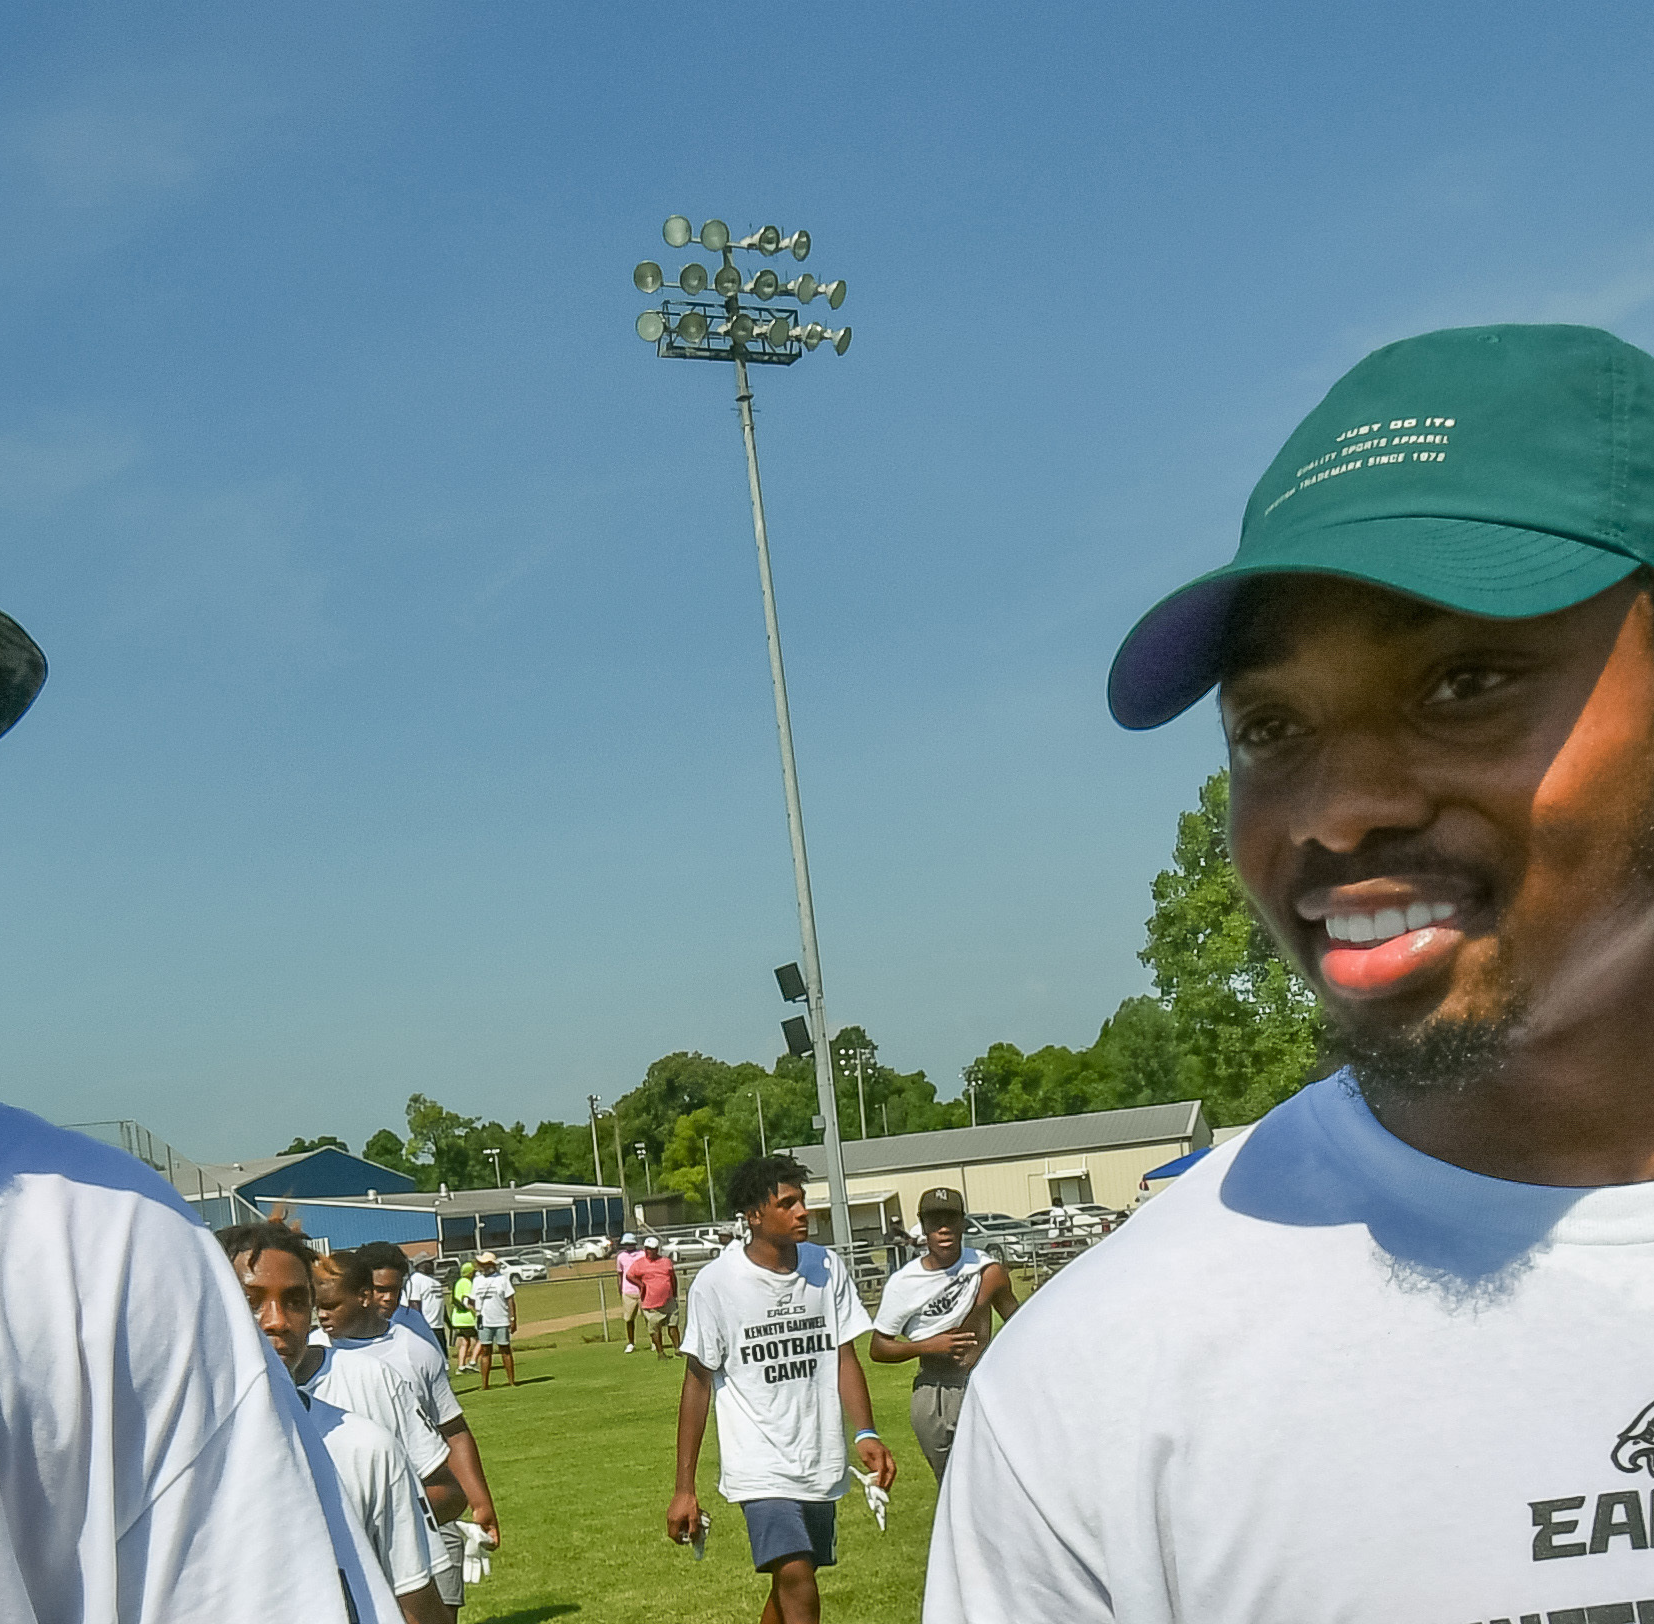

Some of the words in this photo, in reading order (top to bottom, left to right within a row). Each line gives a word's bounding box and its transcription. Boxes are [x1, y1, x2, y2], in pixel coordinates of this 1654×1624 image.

[1336, 423, 1381, 441] JUST
[1389, 419, 1417, 429] DO
[1341, 438, 1388, 456] SPORTS
[1392, 434, 1449, 445] APPAREL
[1299, 459, 1363, 490] TRADEMARK
[1367, 452, 1406, 467] SINCE
[767, 1305, 806, 1318] EAGLES
[744, 1322, 784, 1340] KENNETH
[740, 1333, 836, 1364] FOOTBALL
[764, 1358, 818, 1384] CAMP
